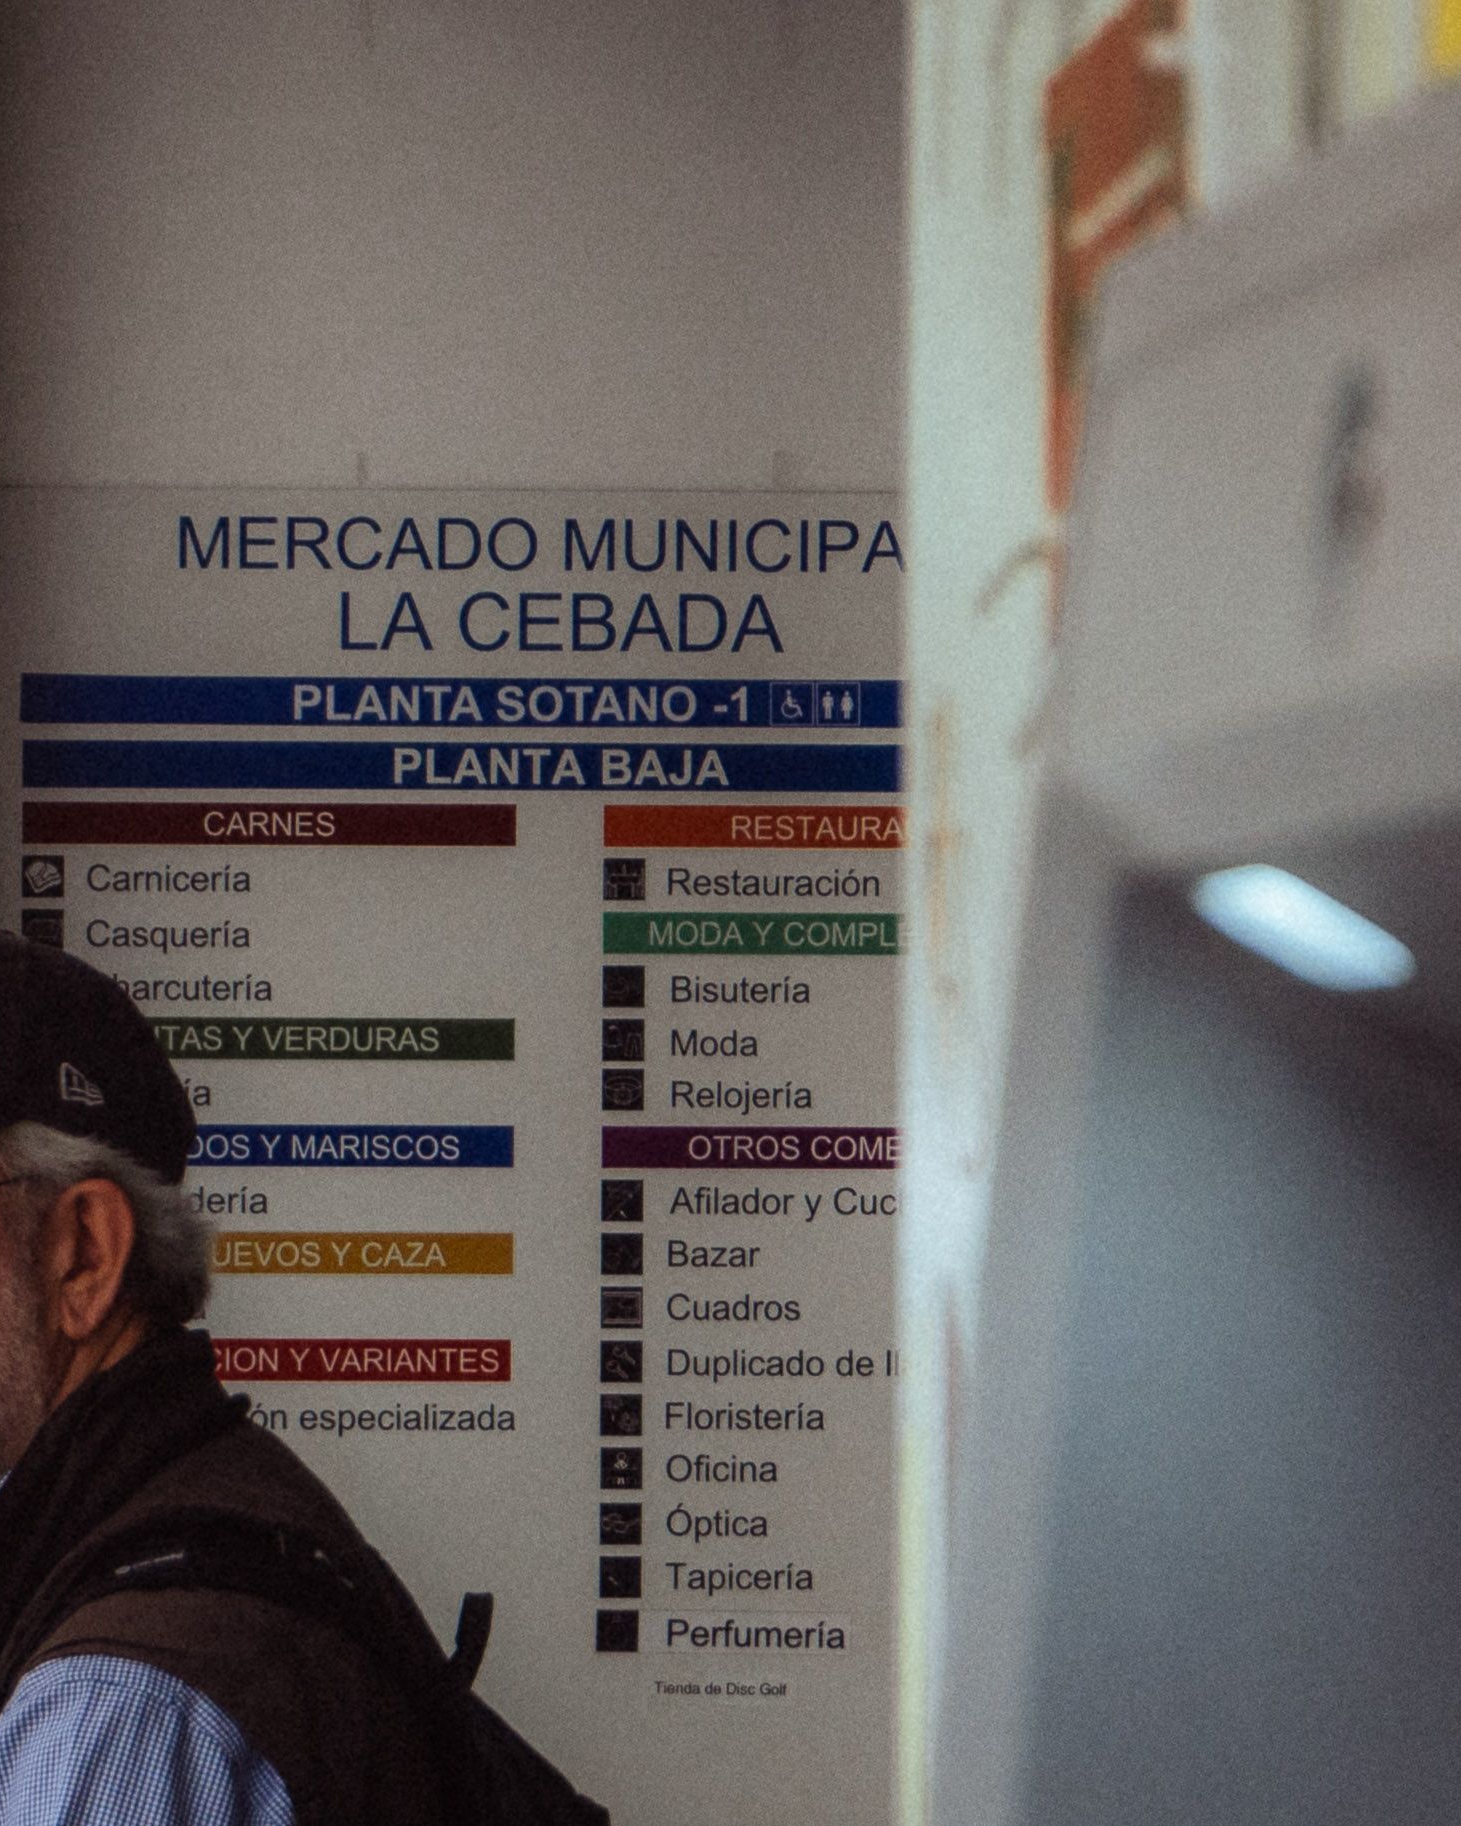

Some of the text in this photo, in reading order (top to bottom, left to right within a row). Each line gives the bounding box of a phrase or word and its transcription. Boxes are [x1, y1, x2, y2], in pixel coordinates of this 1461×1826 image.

[178, 515, 538, 572] MERCADO
[340, 591, 784, 653] LA CEBADA
[291, 684, 751, 725] PLANTA SOTANO -1
[393, 747, 729, 786] PLANTA BAJA
[203, 810, 336, 838] CARNES
[85, 862, 251, 893] Carnicería
[667, 867, 880, 898] Restauración
[84, 918, 250, 953] Casquería
[648, 920, 744, 947] MODA
[752, 921, 775, 947] Y
[670, 975, 810, 1005] Bisutería
[232, 1025, 254, 1051] Y
[262, 1025, 440, 1053] VERDURAS
[670, 1028, 758, 1058] Moda
[670, 1080, 812, 1116] Relojería
[260, 1134, 281, 1160] Y
[291, 1134, 461, 1161] MARISCOS
[687, 1134, 801, 1162] OTROS
[669, 1186, 795, 1216] Afilador
[804, 1194, 823, 1223] y
[330, 1241, 352, 1267] Y
[360, 1241, 447, 1268] CAZA
[667, 1239, 761, 1269] Bazar
[666, 1292, 801, 1322] Cuadros
[289, 1347, 311, 1373] Y
[319, 1347, 500, 1374] VARIANTES
[666, 1348, 825, 1384] Duplicado
[835, 1349, 875, 1378] de
[298, 1403, 516, 1438] especializada
[664, 1401, 825, 1431] Floristería
[665, 1453, 778, 1484] Oficina
[665, 1502, 768, 1544] Óptica
[665, 1561, 814, 1597] Tapicería
[666, 1618, 845, 1650] Perfumería
[654, 1680, 788, 1697] Tienda de Disc Golf
